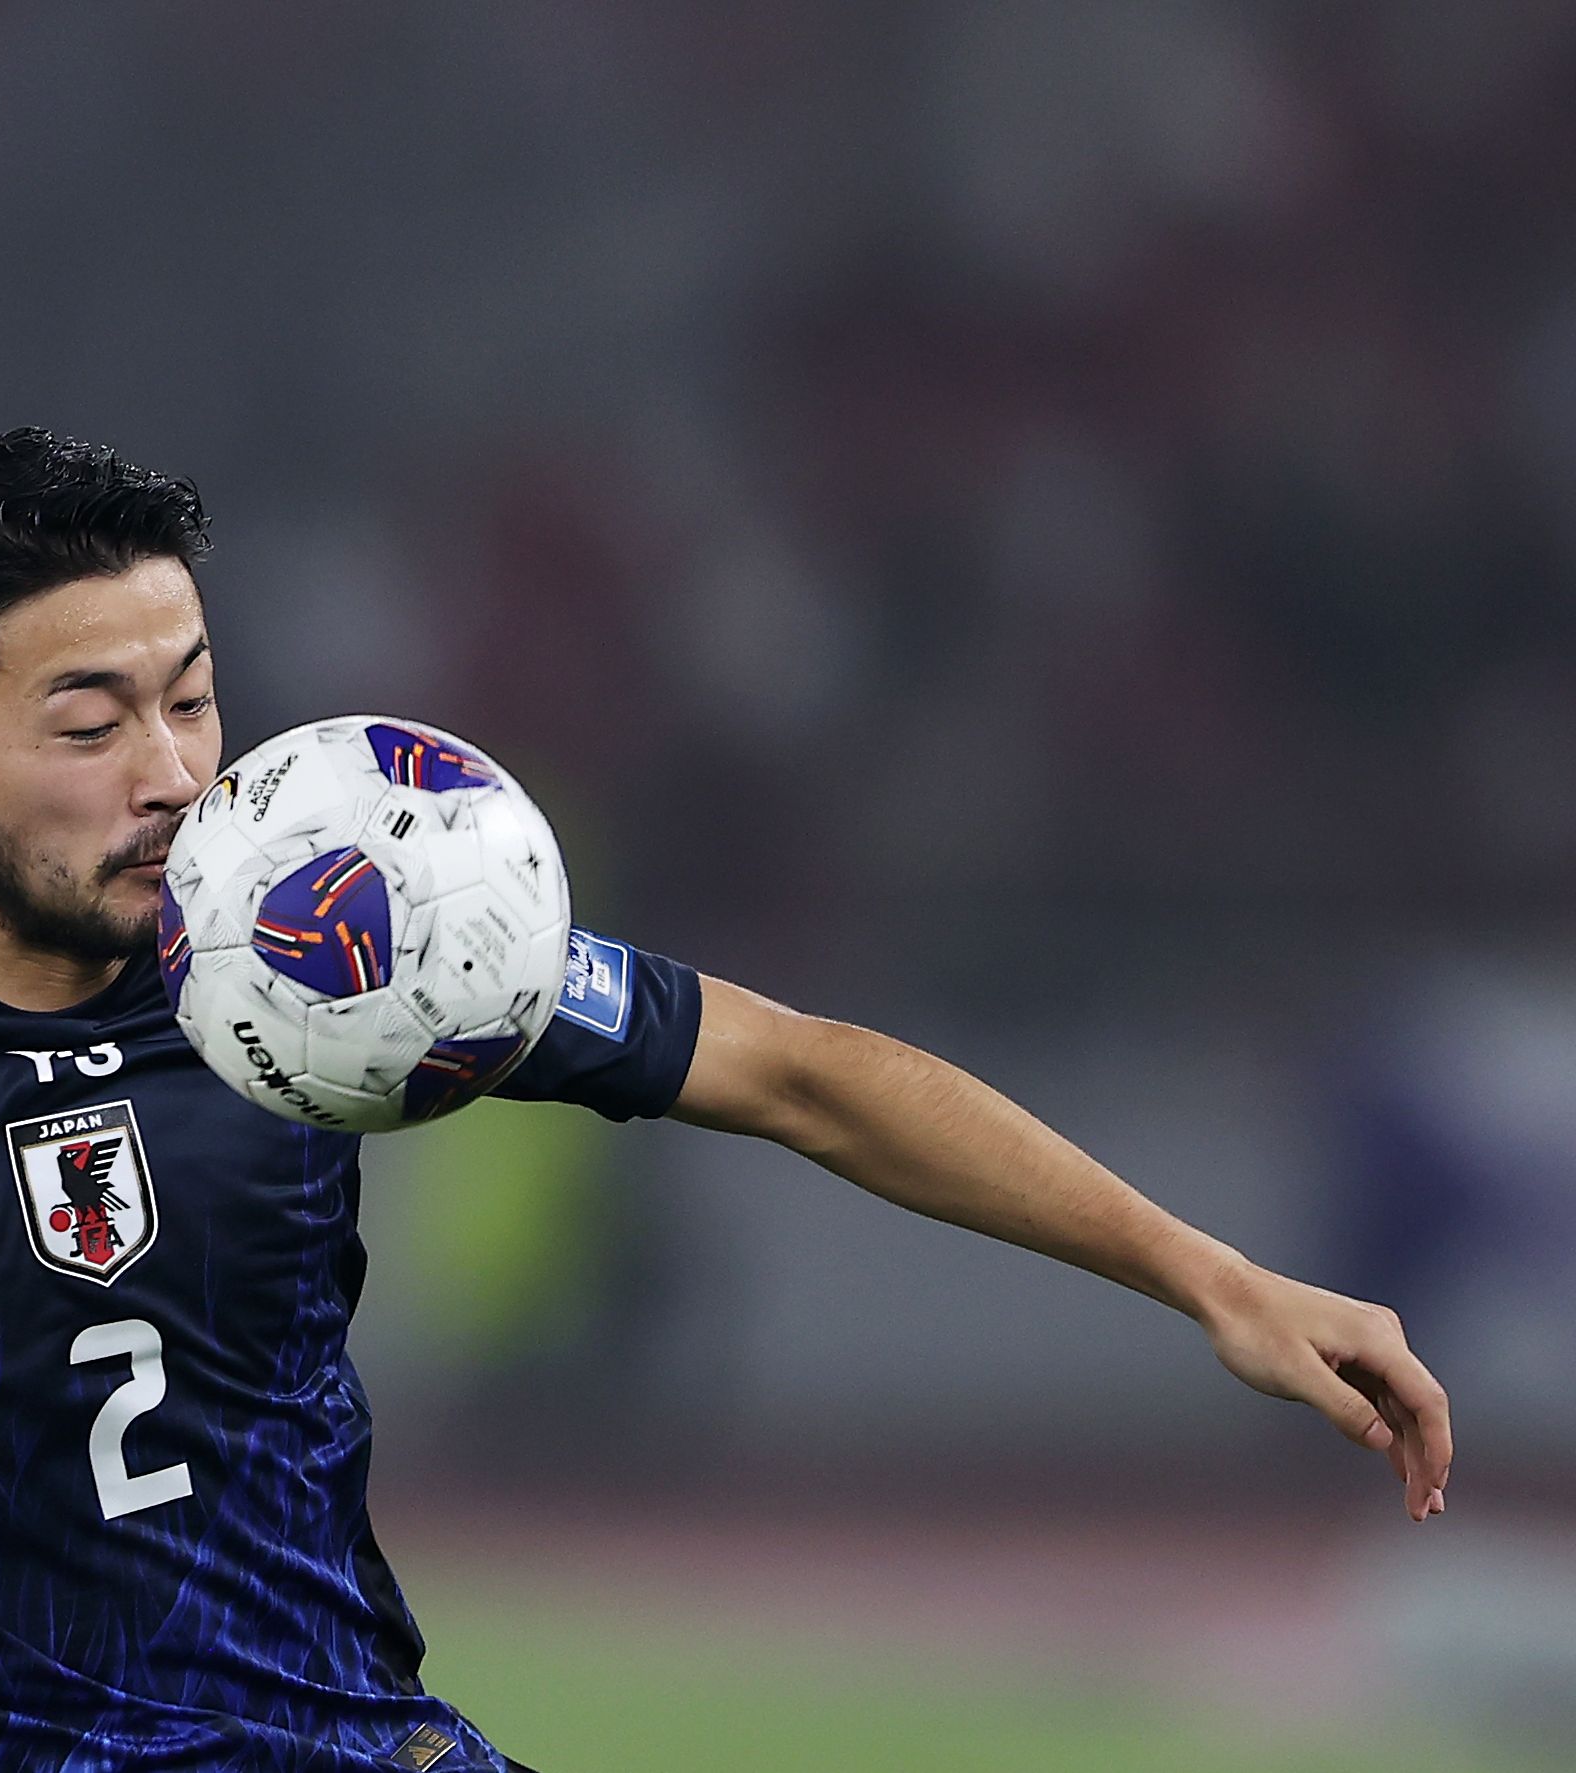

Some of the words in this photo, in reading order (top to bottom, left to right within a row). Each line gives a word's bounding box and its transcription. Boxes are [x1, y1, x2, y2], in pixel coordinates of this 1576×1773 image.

[250, 767, 276, 806] ASIAN
[4, 1042, 123, 1083] Y-3
[38, 1114, 103, 1139] JAPAN
[69, 1318, 194, 1521] 2
